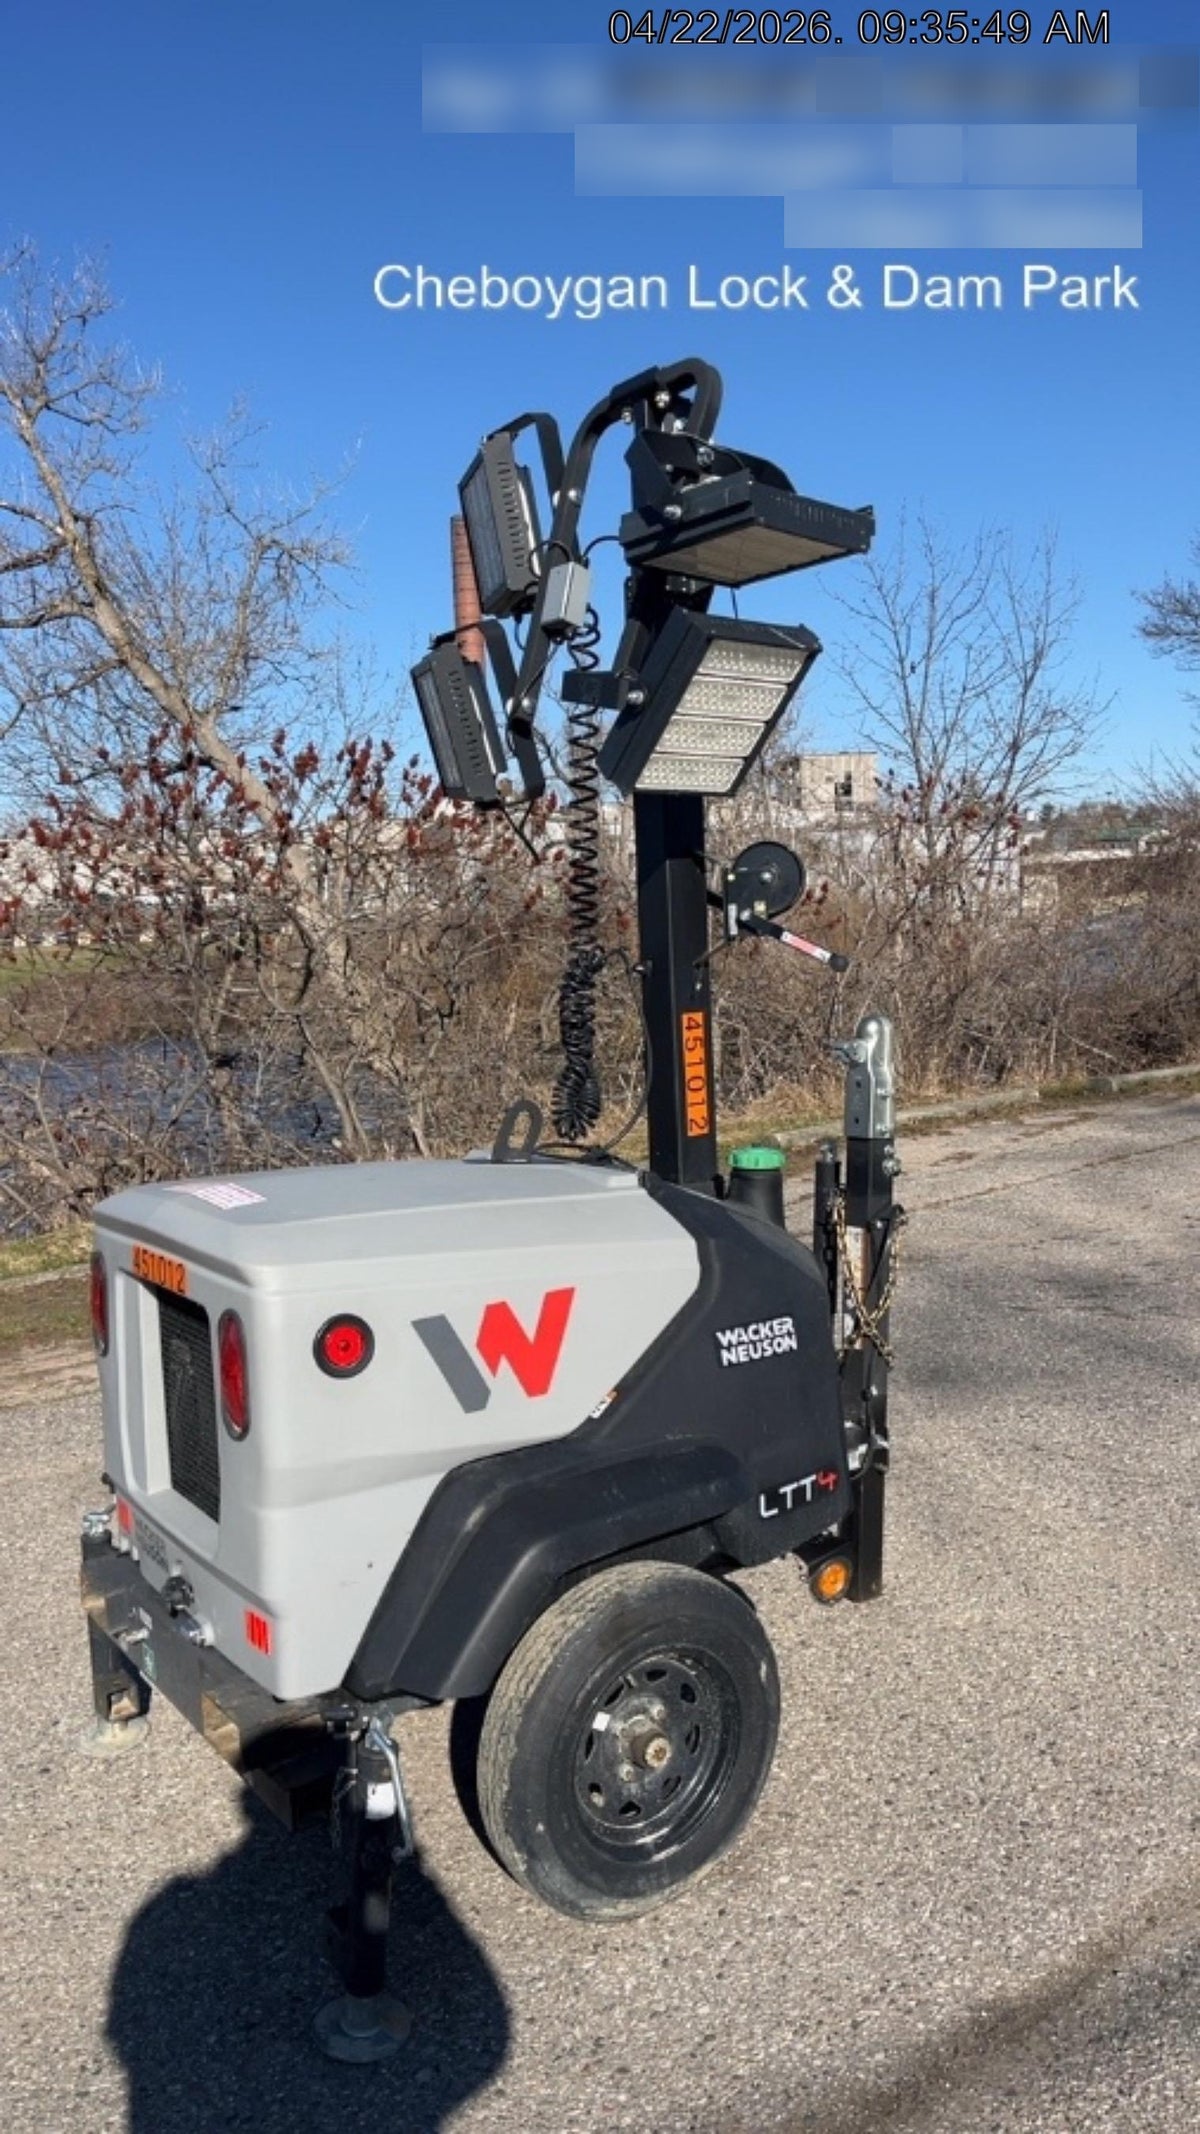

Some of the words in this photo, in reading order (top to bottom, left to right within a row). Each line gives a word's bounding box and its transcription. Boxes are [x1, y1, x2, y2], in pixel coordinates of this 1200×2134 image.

[685, 1017, 708, 1132] 451012
[133, 1246, 186, 1293] 451012
[716, 1316, 795, 1346] WACKER
[720, 1335, 798, 1367] NEUSON
[759, 1471, 838, 1518] LTT4
